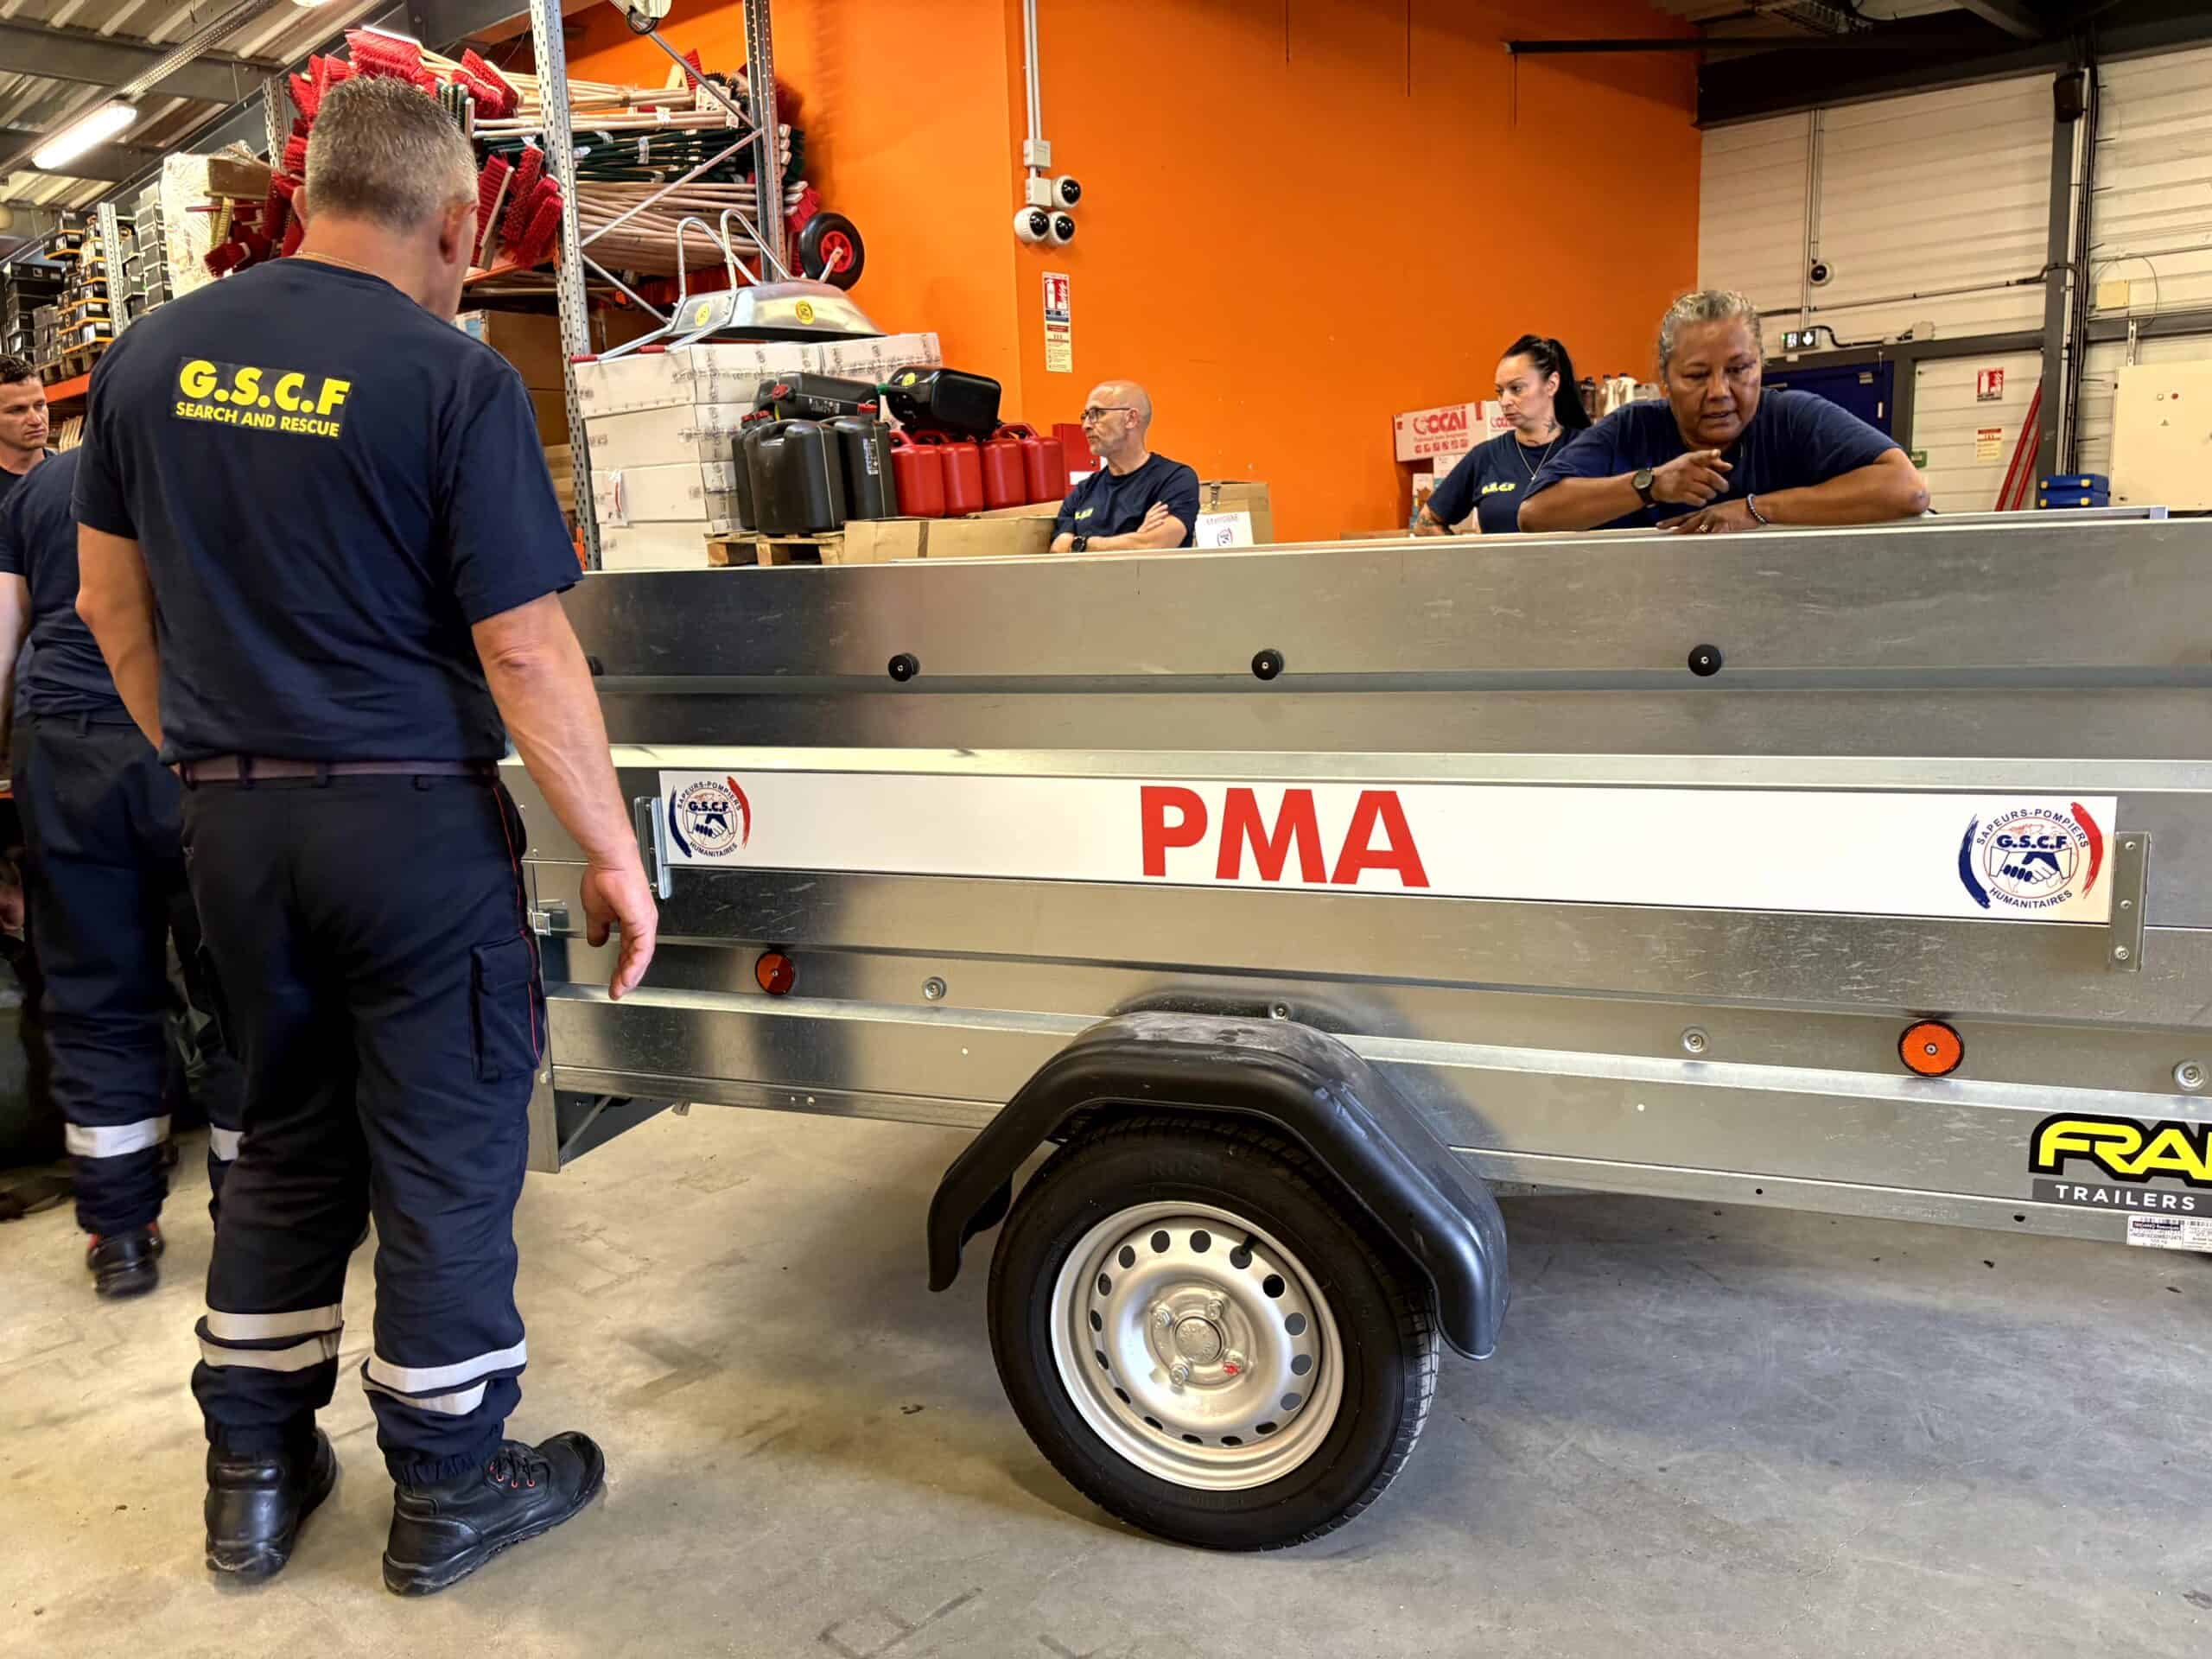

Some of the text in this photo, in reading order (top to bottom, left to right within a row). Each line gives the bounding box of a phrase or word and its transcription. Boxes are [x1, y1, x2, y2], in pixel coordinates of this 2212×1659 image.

[180, 359, 351, 415] G.S.C.F
[176, 402, 340, 437] SEARCH AND RESCUE
[689, 801, 728, 812] G.S.C.F
[1141, 785, 1431, 888] PMA
[1976, 809, 2089, 849] SAPEURS-POMPIERS
[1997, 835, 2067, 849] G.S.C.F
[690, 842, 737, 857] HUMANITAIRES
[1989, 886, 2073, 909] HUMANITAIRES
[2055, 1185, 2196, 1211] TRAILERS
